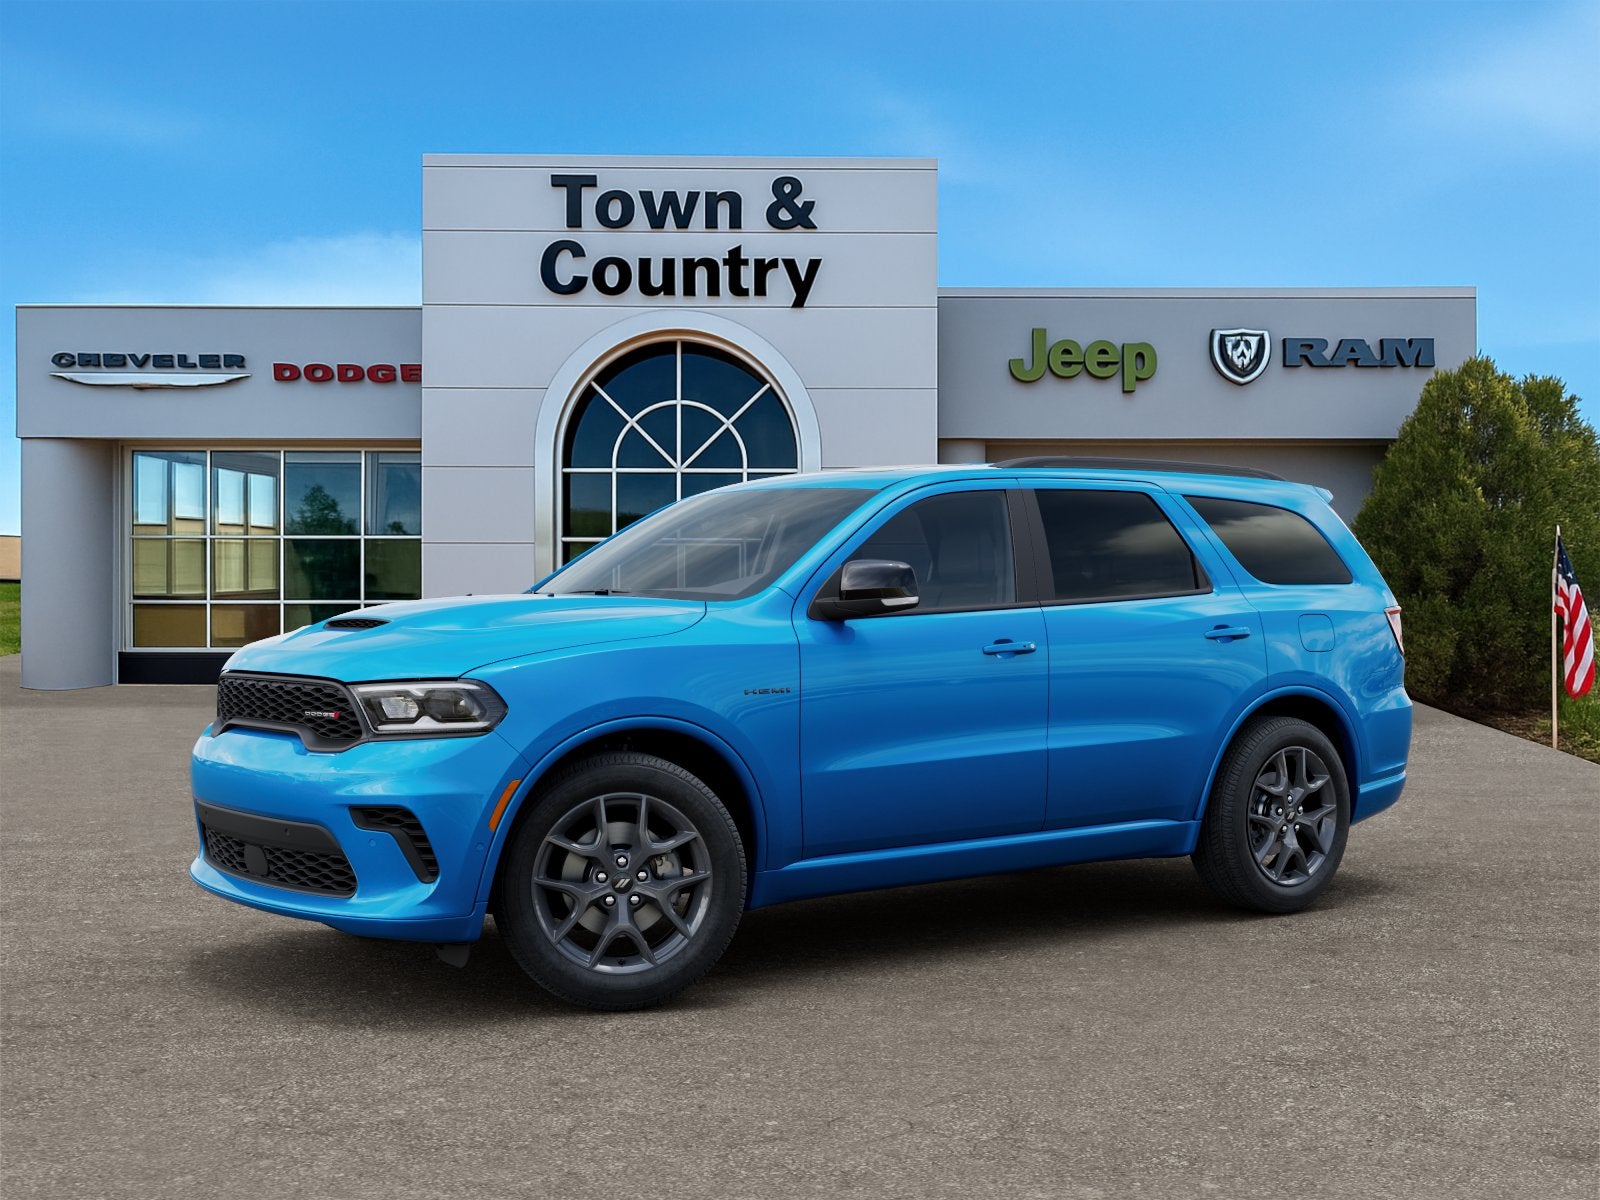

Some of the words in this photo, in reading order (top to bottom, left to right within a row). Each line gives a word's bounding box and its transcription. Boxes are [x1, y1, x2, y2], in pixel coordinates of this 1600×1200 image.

[550, 174, 743, 229] Town
[765, 175, 818, 230] &
[540, 239, 823, 308] Country
[272, 362, 422, 383] DODGE
[1009, 327, 1157, 393] Jeep
[1283, 337, 1435, 368] RAM
[743, 687, 792, 696] HEMI
